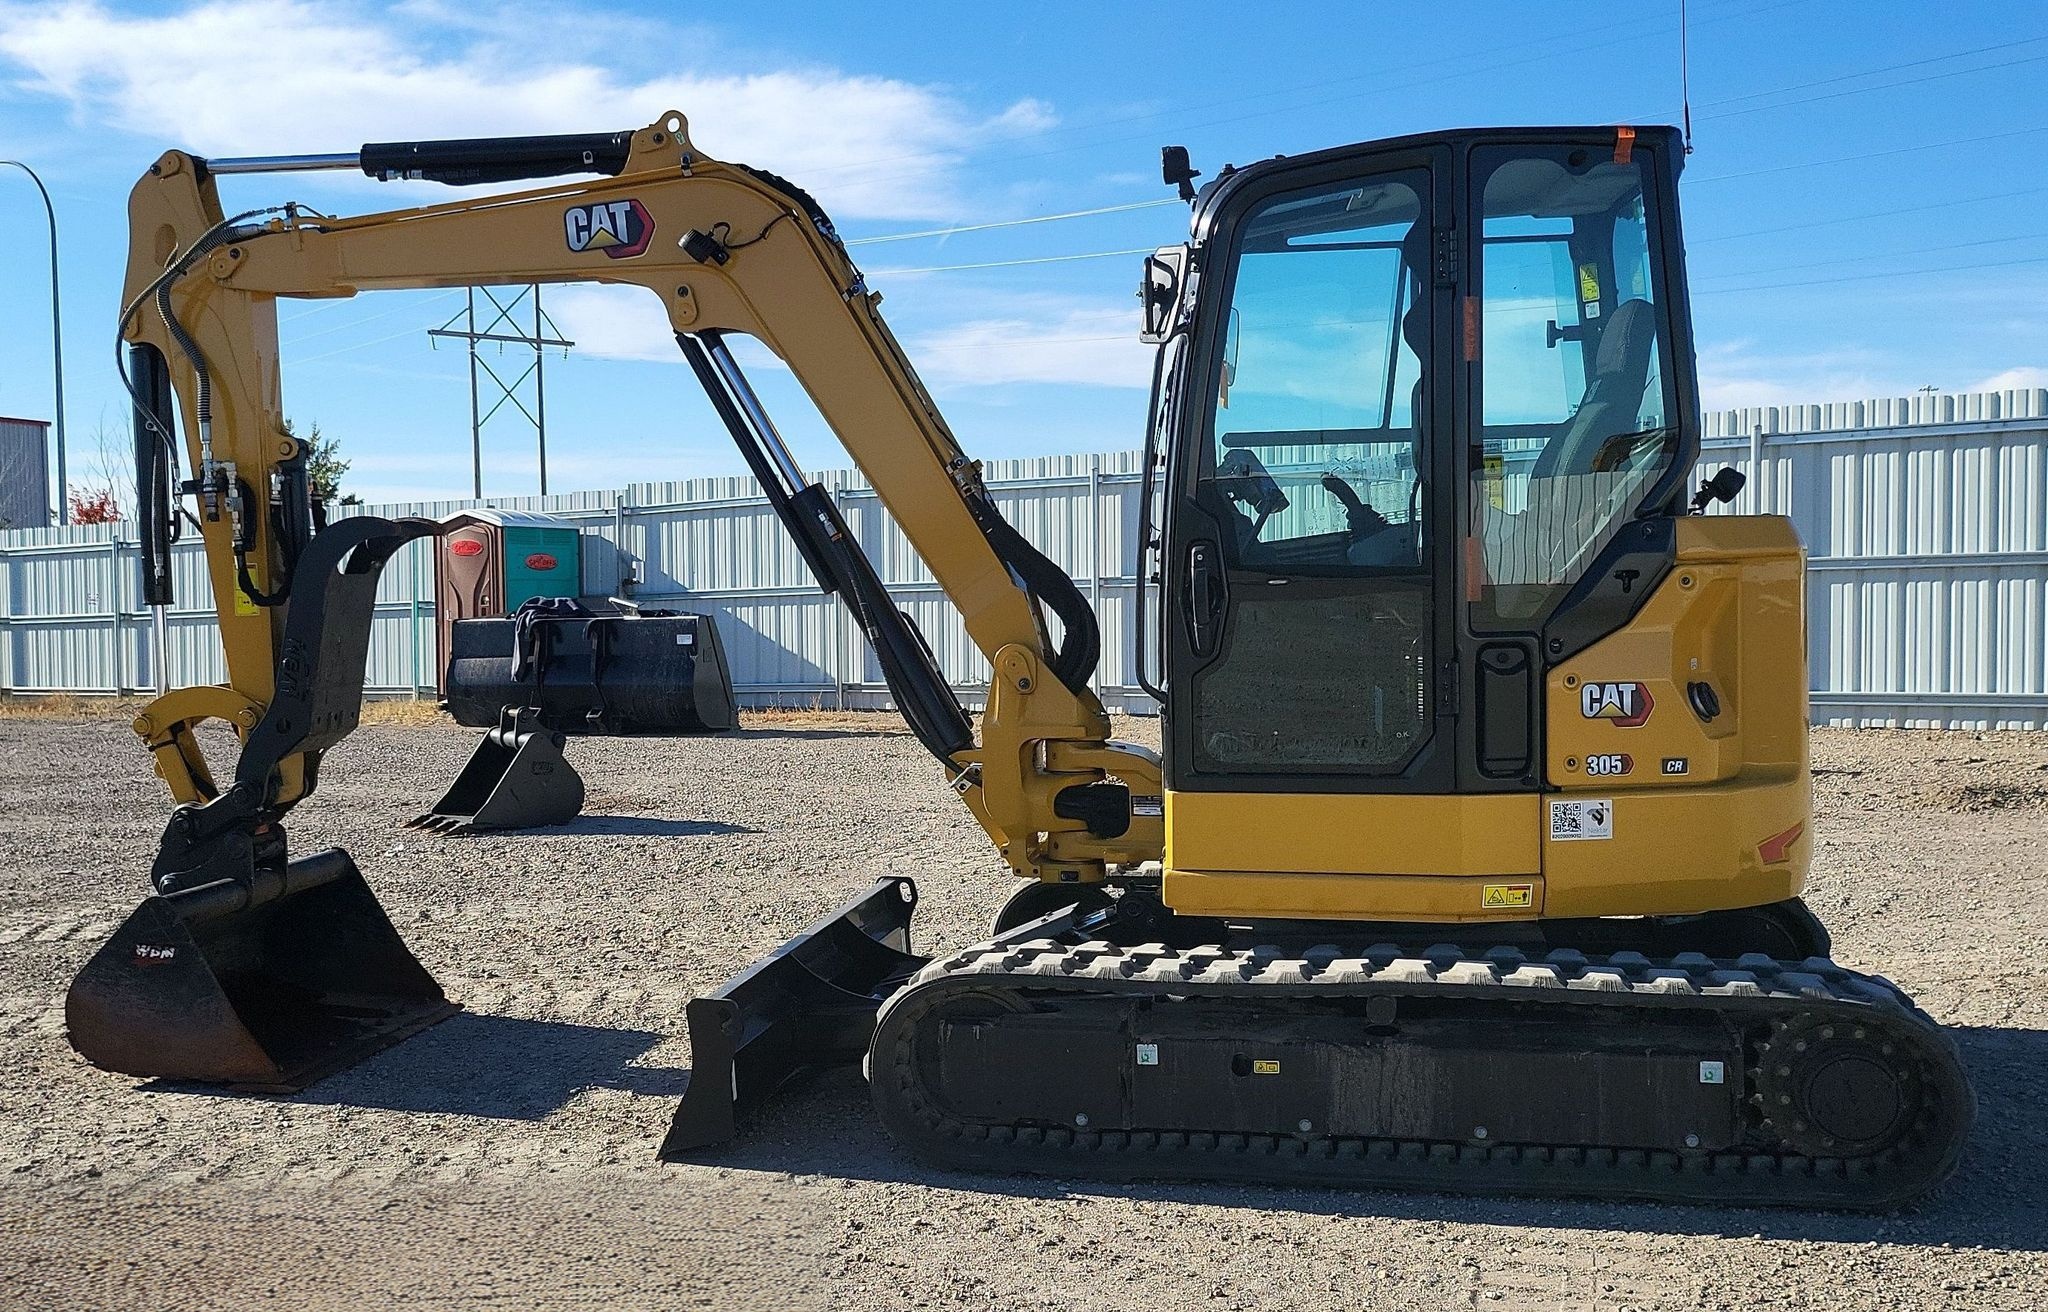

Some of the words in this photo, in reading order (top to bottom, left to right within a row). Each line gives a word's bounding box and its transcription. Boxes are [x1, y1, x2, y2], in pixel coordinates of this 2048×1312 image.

[565, 201, 631, 251] CAT
[1582, 683, 1637, 717] CAT
[1586, 754, 1623, 775] 305
[1666, 760, 1684, 772] CR
